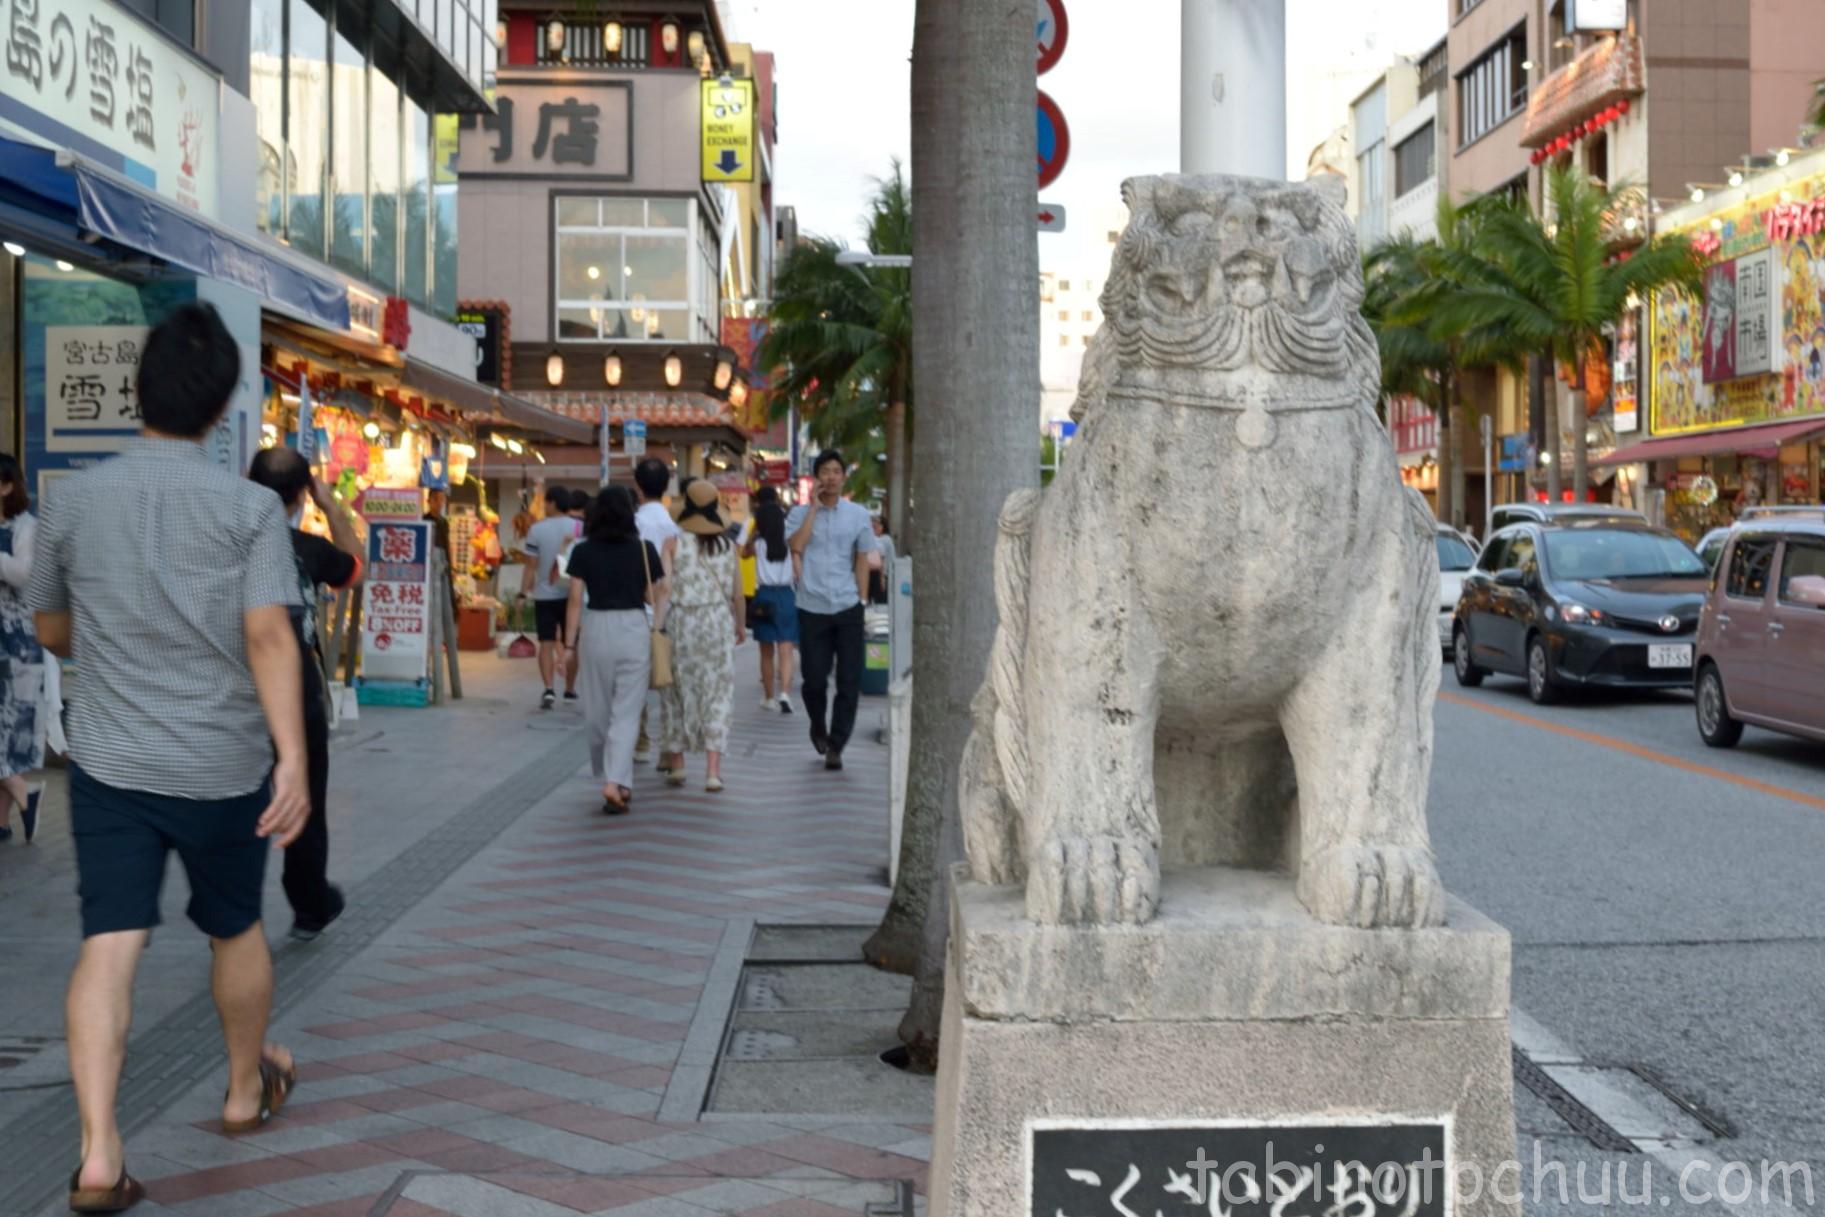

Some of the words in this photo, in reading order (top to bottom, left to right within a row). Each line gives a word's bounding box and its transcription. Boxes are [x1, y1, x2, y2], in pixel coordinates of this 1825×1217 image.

[707, 124, 734, 134] MONEY
[707, 136, 748, 146] EXCHANGE
[370, 583, 424, 605] 免税
